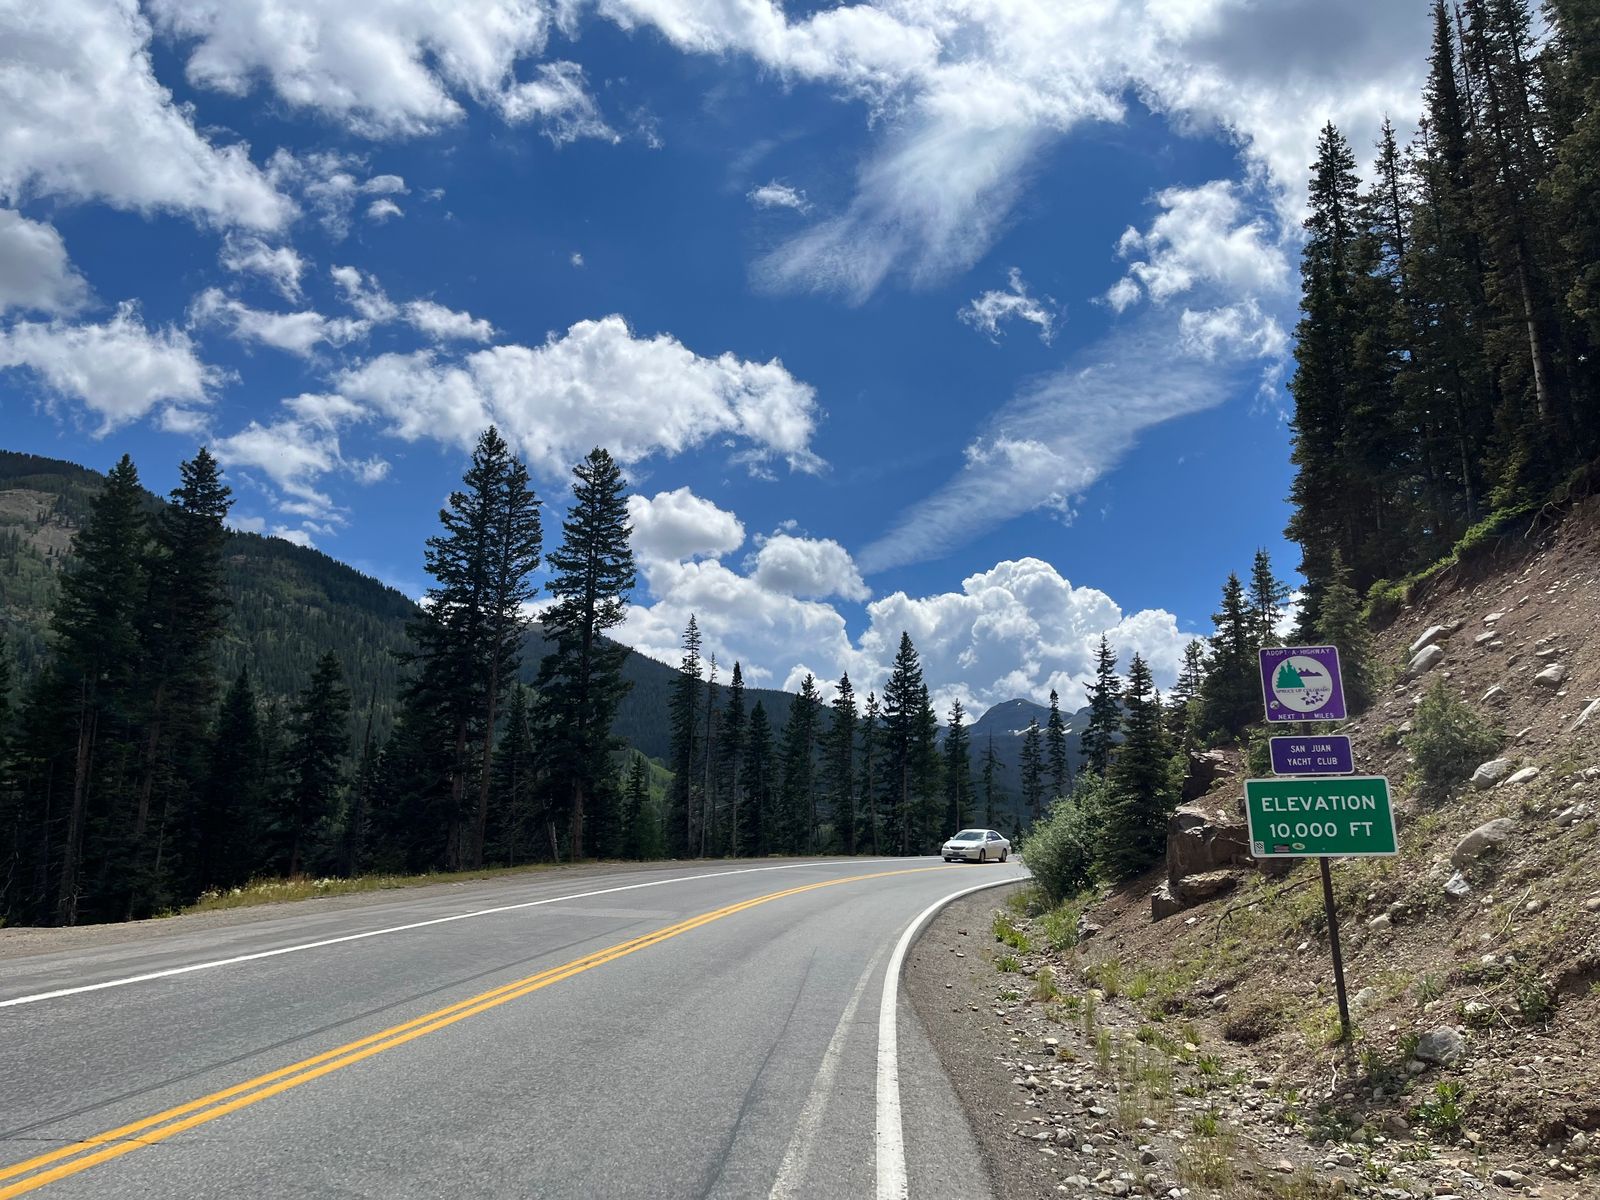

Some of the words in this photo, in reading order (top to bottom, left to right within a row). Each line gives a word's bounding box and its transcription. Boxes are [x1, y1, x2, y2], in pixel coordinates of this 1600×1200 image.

[1317, 757, 1338, 765] CLUB
[1262, 795, 1376, 812] ELEVATION
[1350, 822, 1372, 836] FT
